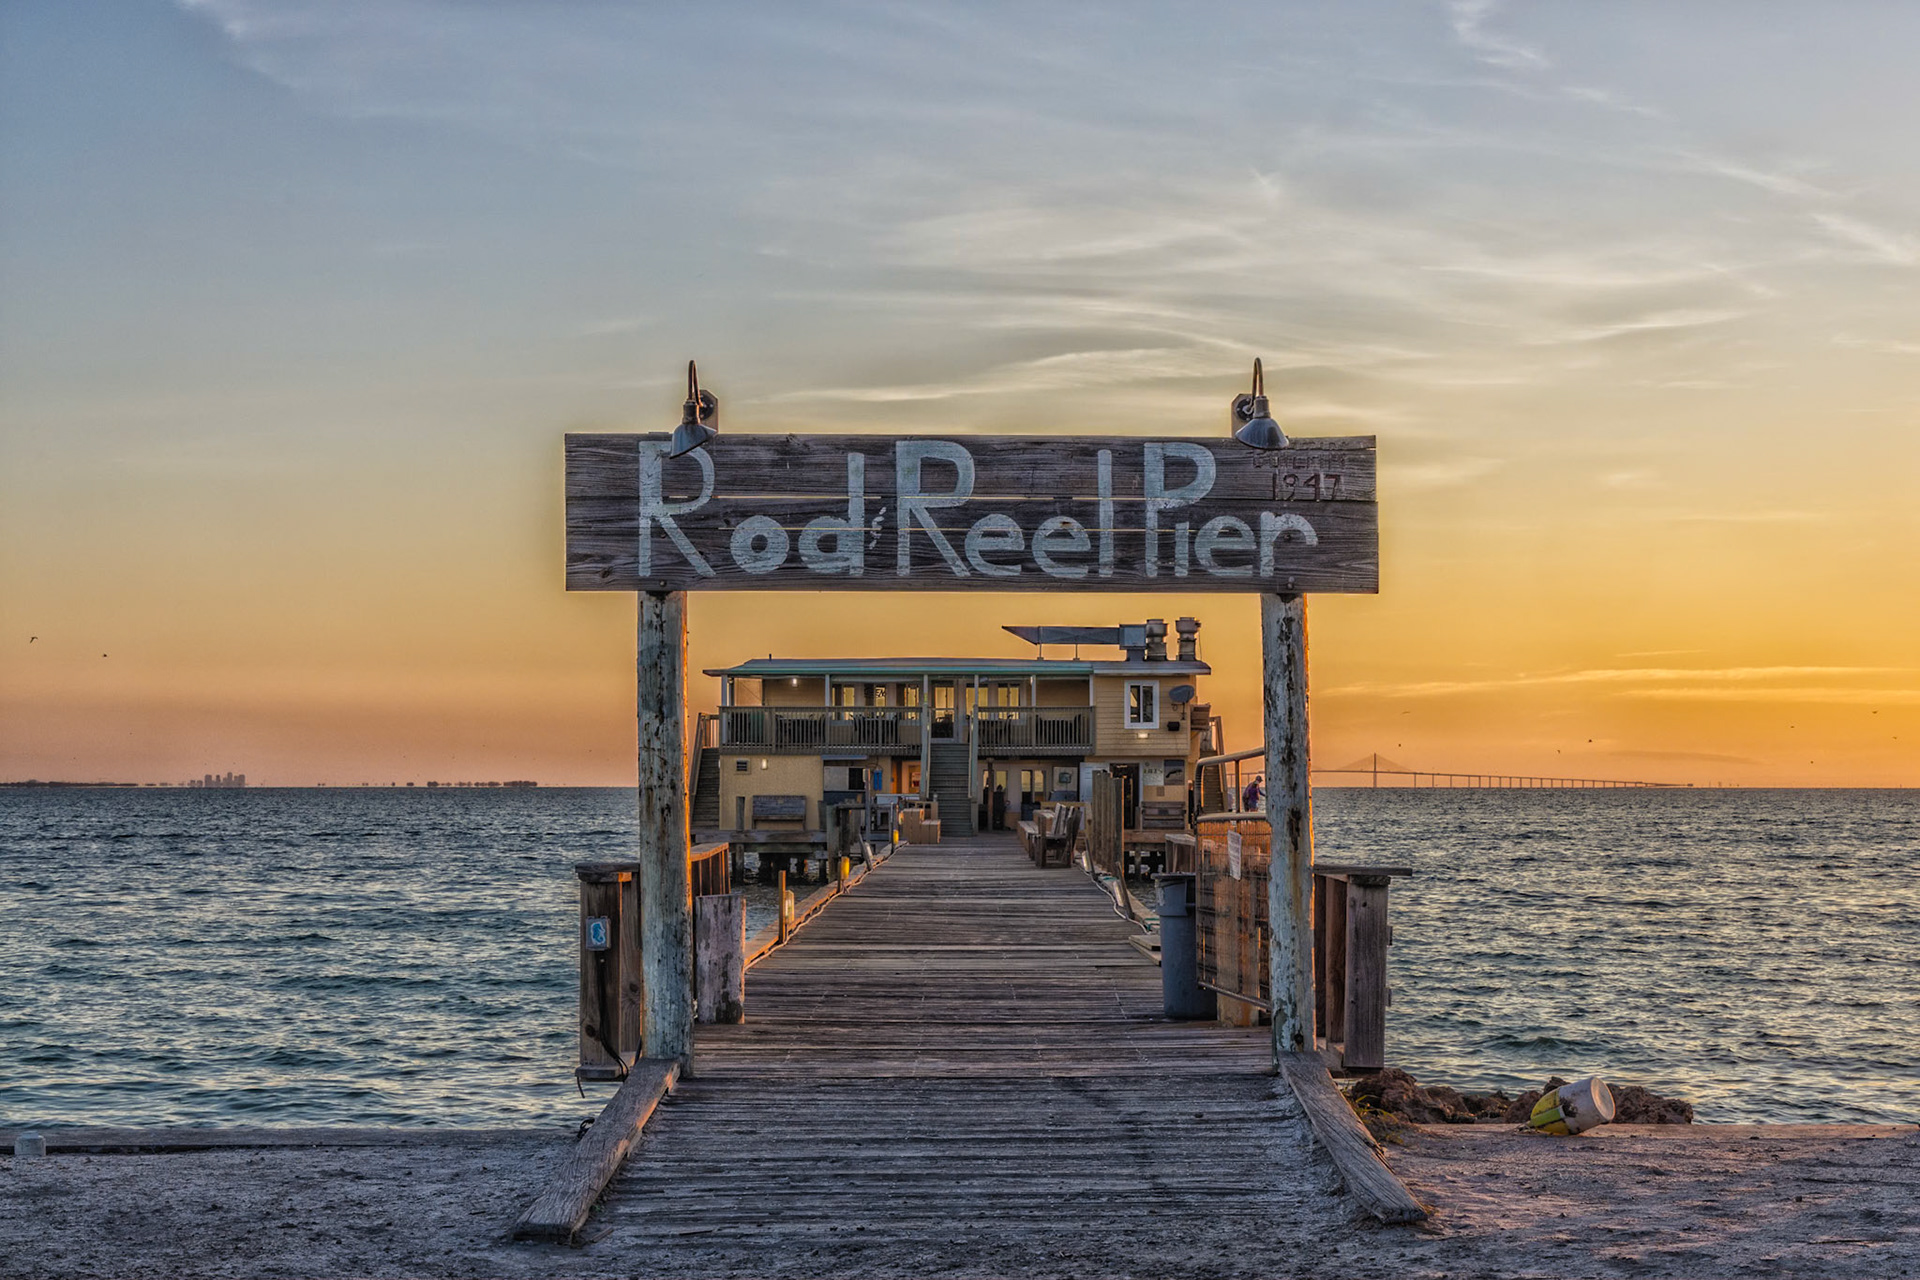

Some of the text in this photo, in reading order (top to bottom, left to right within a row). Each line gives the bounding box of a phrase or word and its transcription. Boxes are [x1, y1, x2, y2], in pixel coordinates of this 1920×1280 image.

[638, 440, 1318, 578] Rod Reel Pier
[1272, 472, 1341, 501] 1947
